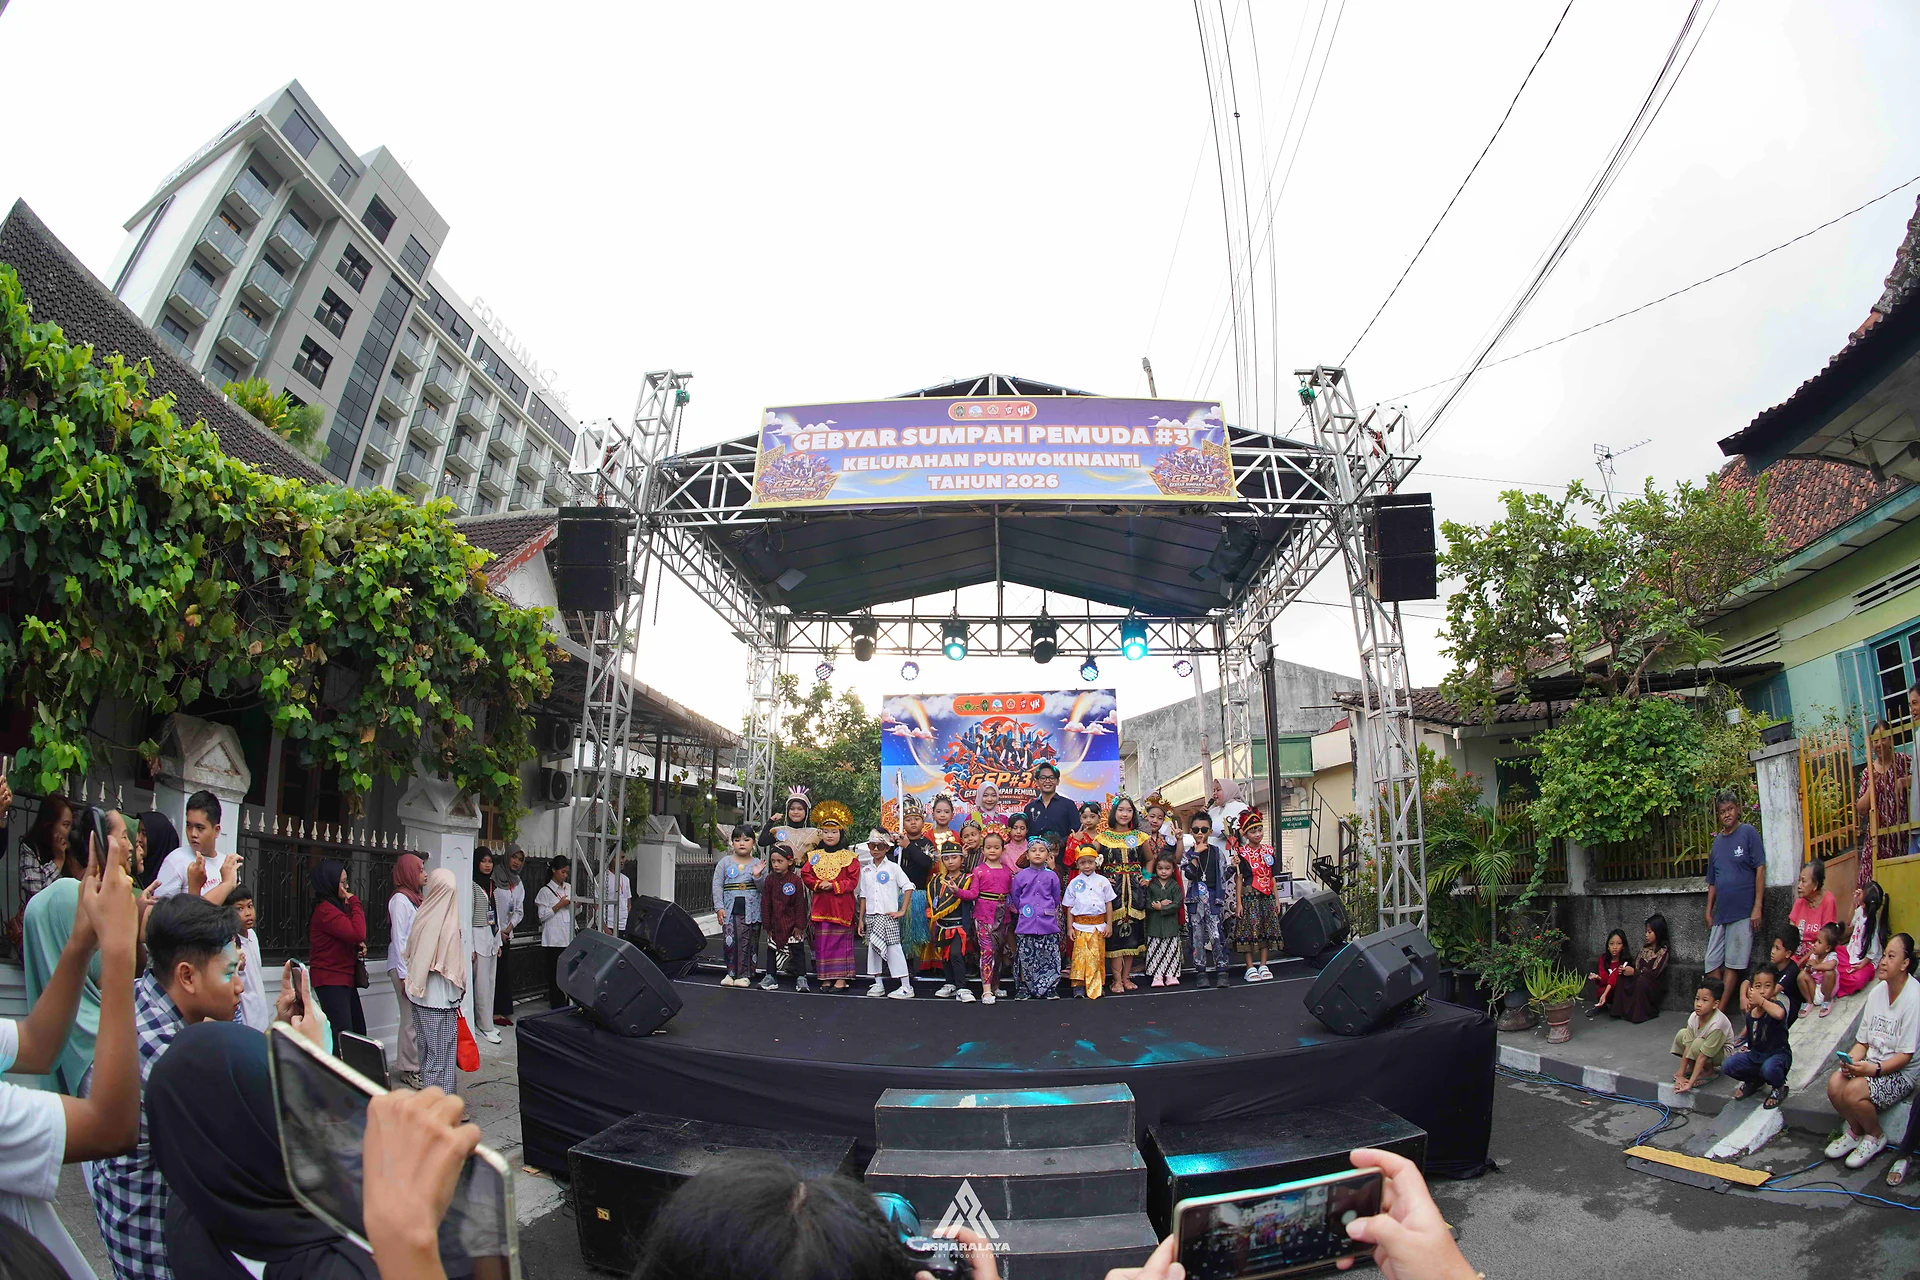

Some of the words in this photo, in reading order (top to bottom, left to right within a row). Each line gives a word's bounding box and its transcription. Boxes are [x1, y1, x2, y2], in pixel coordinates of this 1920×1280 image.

[471, 296, 538, 378] FORTUNA
[793, 429, 897, 450] GEBYAR
[902, 426, 1024, 446] SUMPAH
[1029, 426, 1151, 445] PEMUDA
[1155, 428, 1191, 446] #3
[843, 453, 969, 471] KELURAHAN
[973, 452, 1141, 468] PURWOKINANTI
[927, 474, 1002, 490] TAHUN
[1005, 474, 1059, 488] 2026
[1014, 788, 1037, 797] PEMUDA
[1806, 923, 1820, 932] PIS
